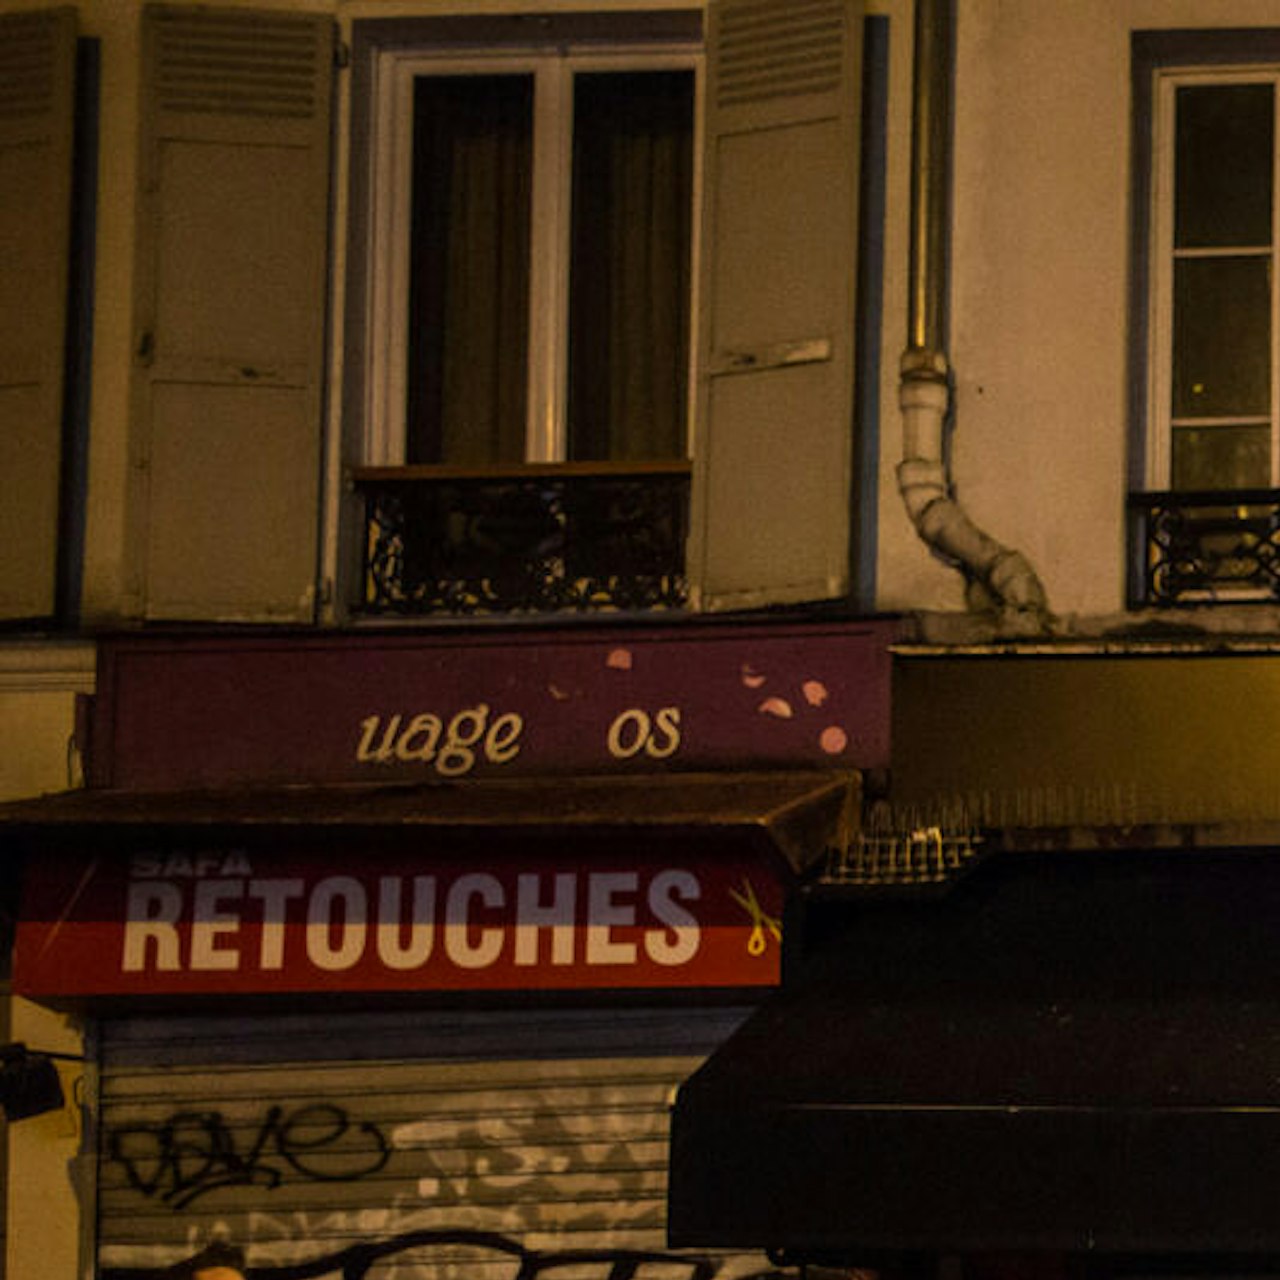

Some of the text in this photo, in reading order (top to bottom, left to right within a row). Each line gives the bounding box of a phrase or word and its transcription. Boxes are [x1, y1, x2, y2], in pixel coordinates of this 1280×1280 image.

[356, 703, 682, 775] uage os
[121, 869, 702, 974] RETOUCHES
